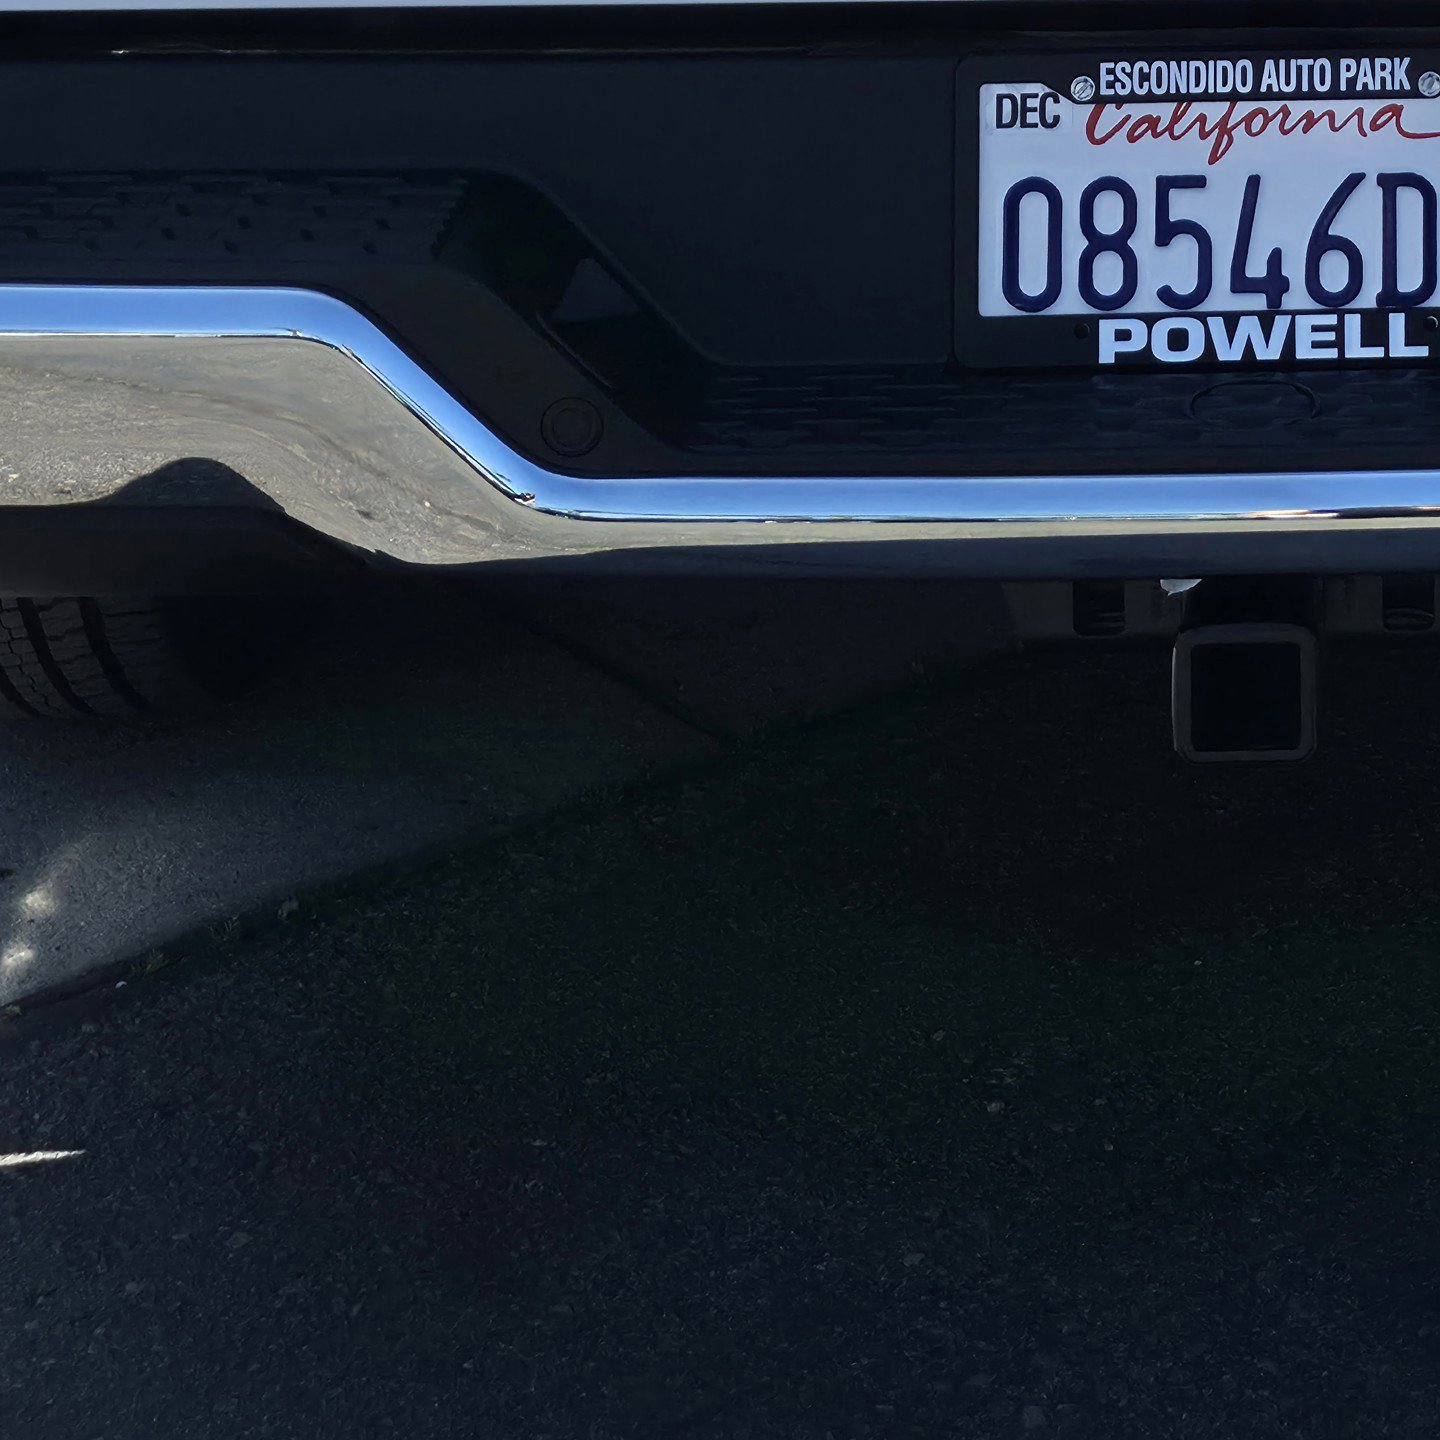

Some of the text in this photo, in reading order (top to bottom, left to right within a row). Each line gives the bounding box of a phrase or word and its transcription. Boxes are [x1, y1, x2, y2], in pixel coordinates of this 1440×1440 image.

[1099, 56, 1412, 96] ESCONDIDO AUTO PARK
[994, 91, 1061, 129] DEC
[1098, 312, 1430, 364] POWELL
